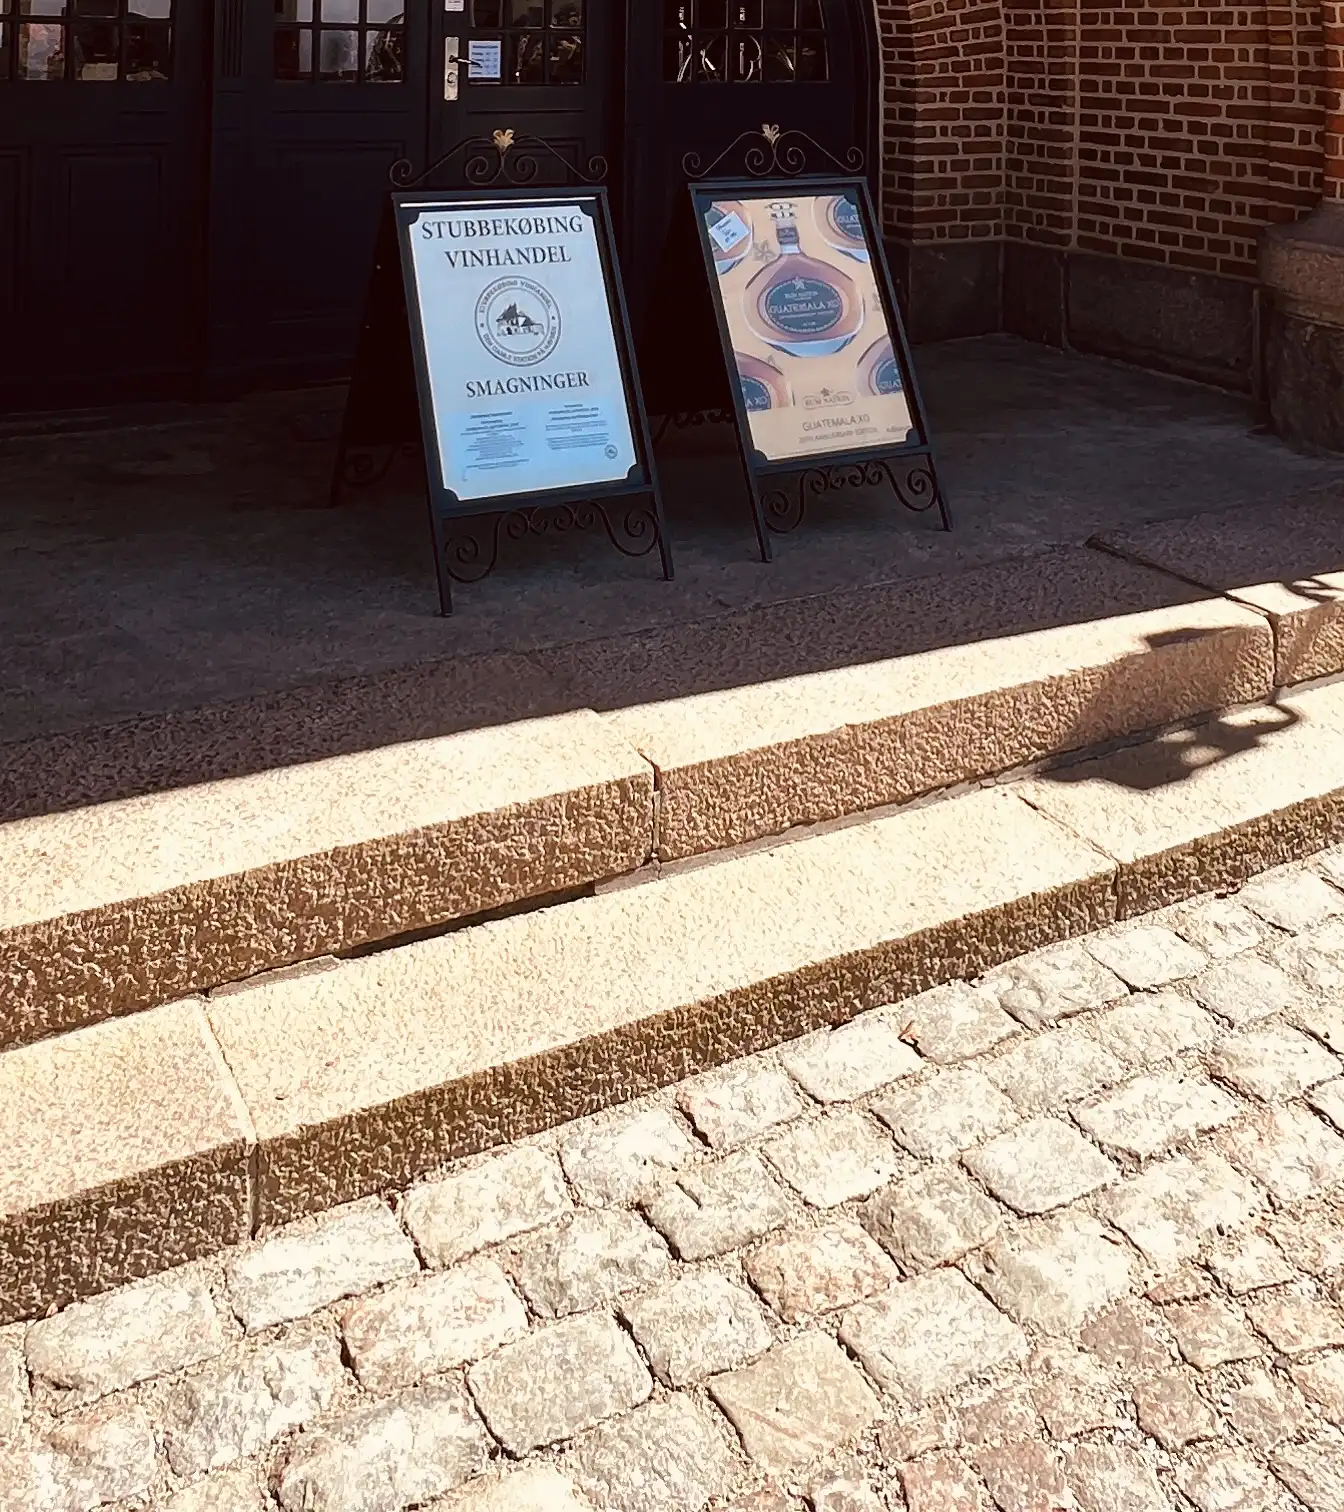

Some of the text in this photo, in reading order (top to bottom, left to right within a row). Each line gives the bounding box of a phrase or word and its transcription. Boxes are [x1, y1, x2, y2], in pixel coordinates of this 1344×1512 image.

[422, 215, 584, 240] STUBBEKØBING
[444, 245, 572, 269] VINHANDEL
[466, 371, 590, 398] SMAGNINGER
[802, 415, 857, 432] GUATEMALA
